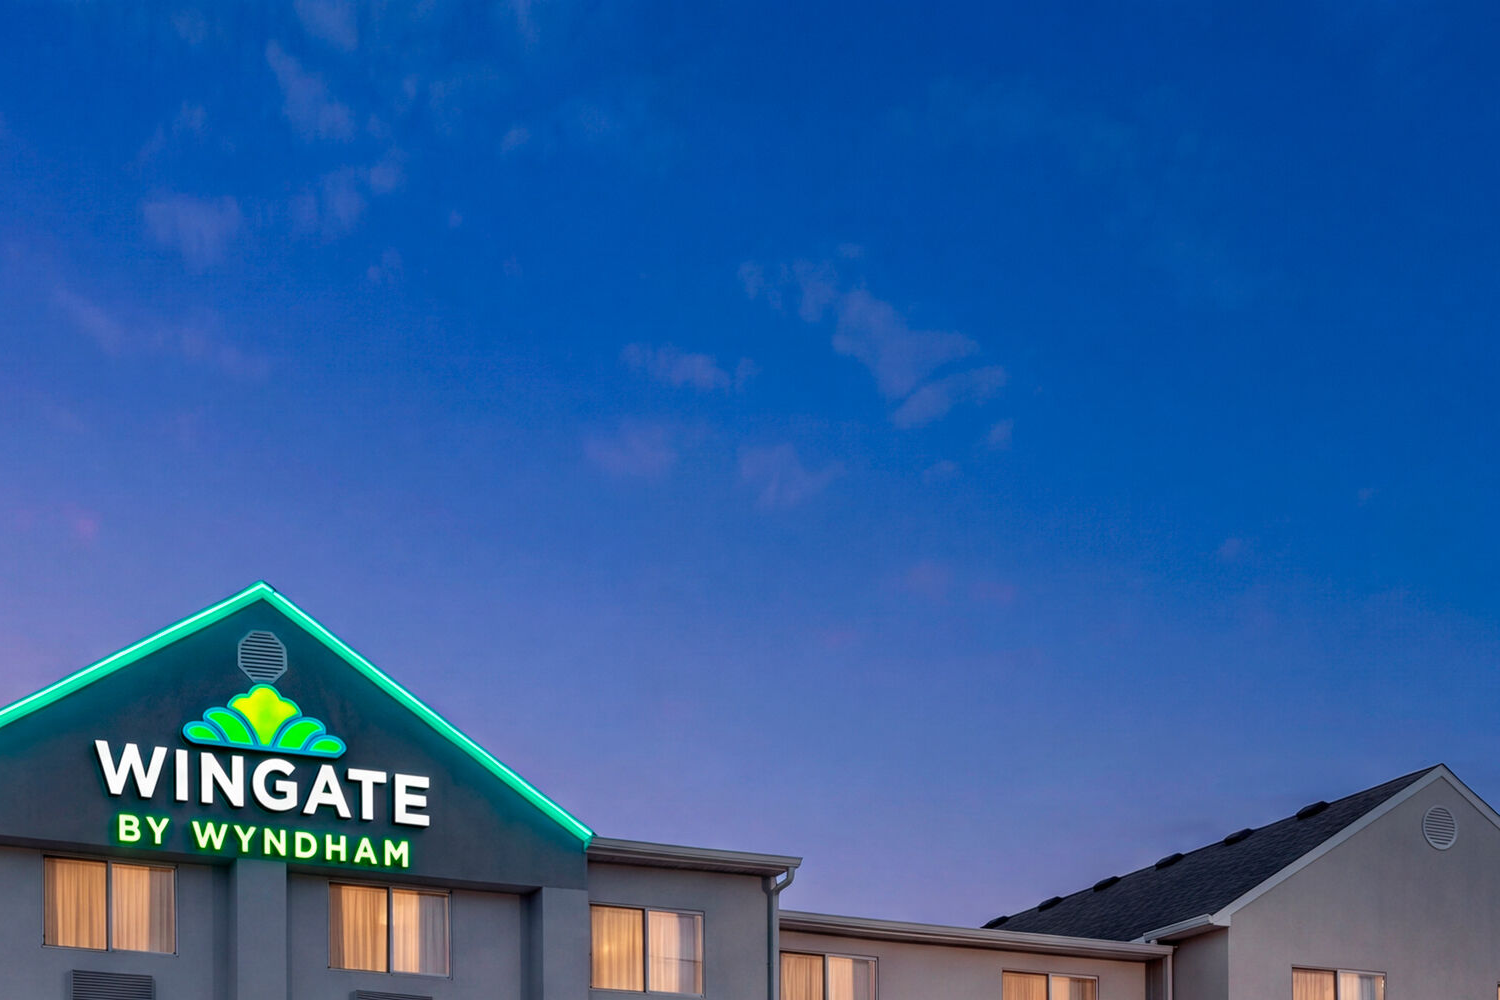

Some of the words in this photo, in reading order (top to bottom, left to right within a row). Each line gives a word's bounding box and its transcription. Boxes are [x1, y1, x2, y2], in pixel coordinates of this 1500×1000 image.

[94, 739, 430, 827] WINGATE
[117, 813, 170, 845] BY
[192, 820, 410, 868] WYNDHAM
